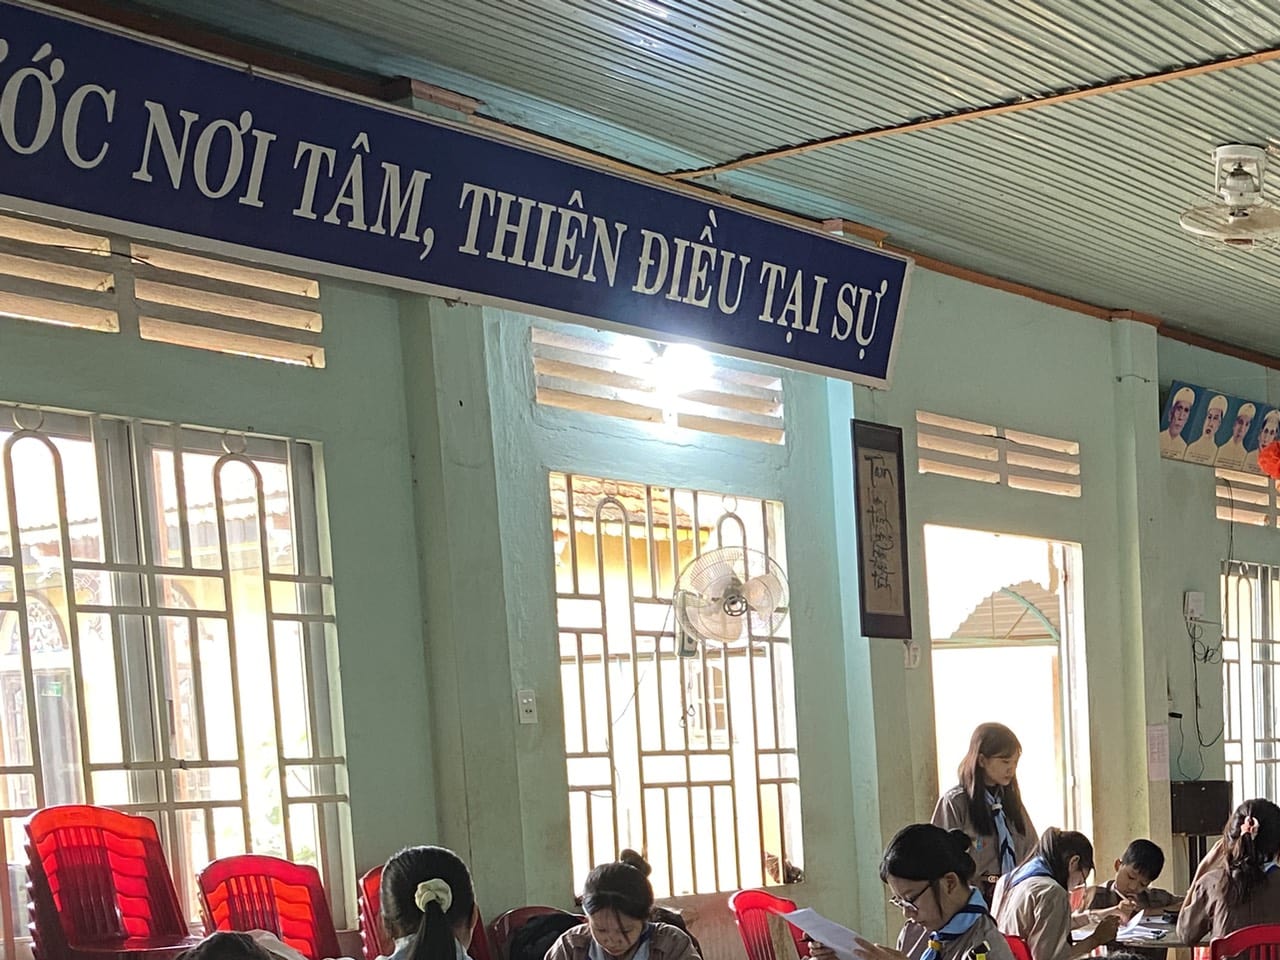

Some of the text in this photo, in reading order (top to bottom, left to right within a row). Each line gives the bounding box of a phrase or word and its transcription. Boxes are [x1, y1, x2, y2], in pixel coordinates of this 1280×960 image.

[0, 38, 888, 360] ỚC NƠI TÂM, THIÊN ĐIỀU TẠI SỰ
